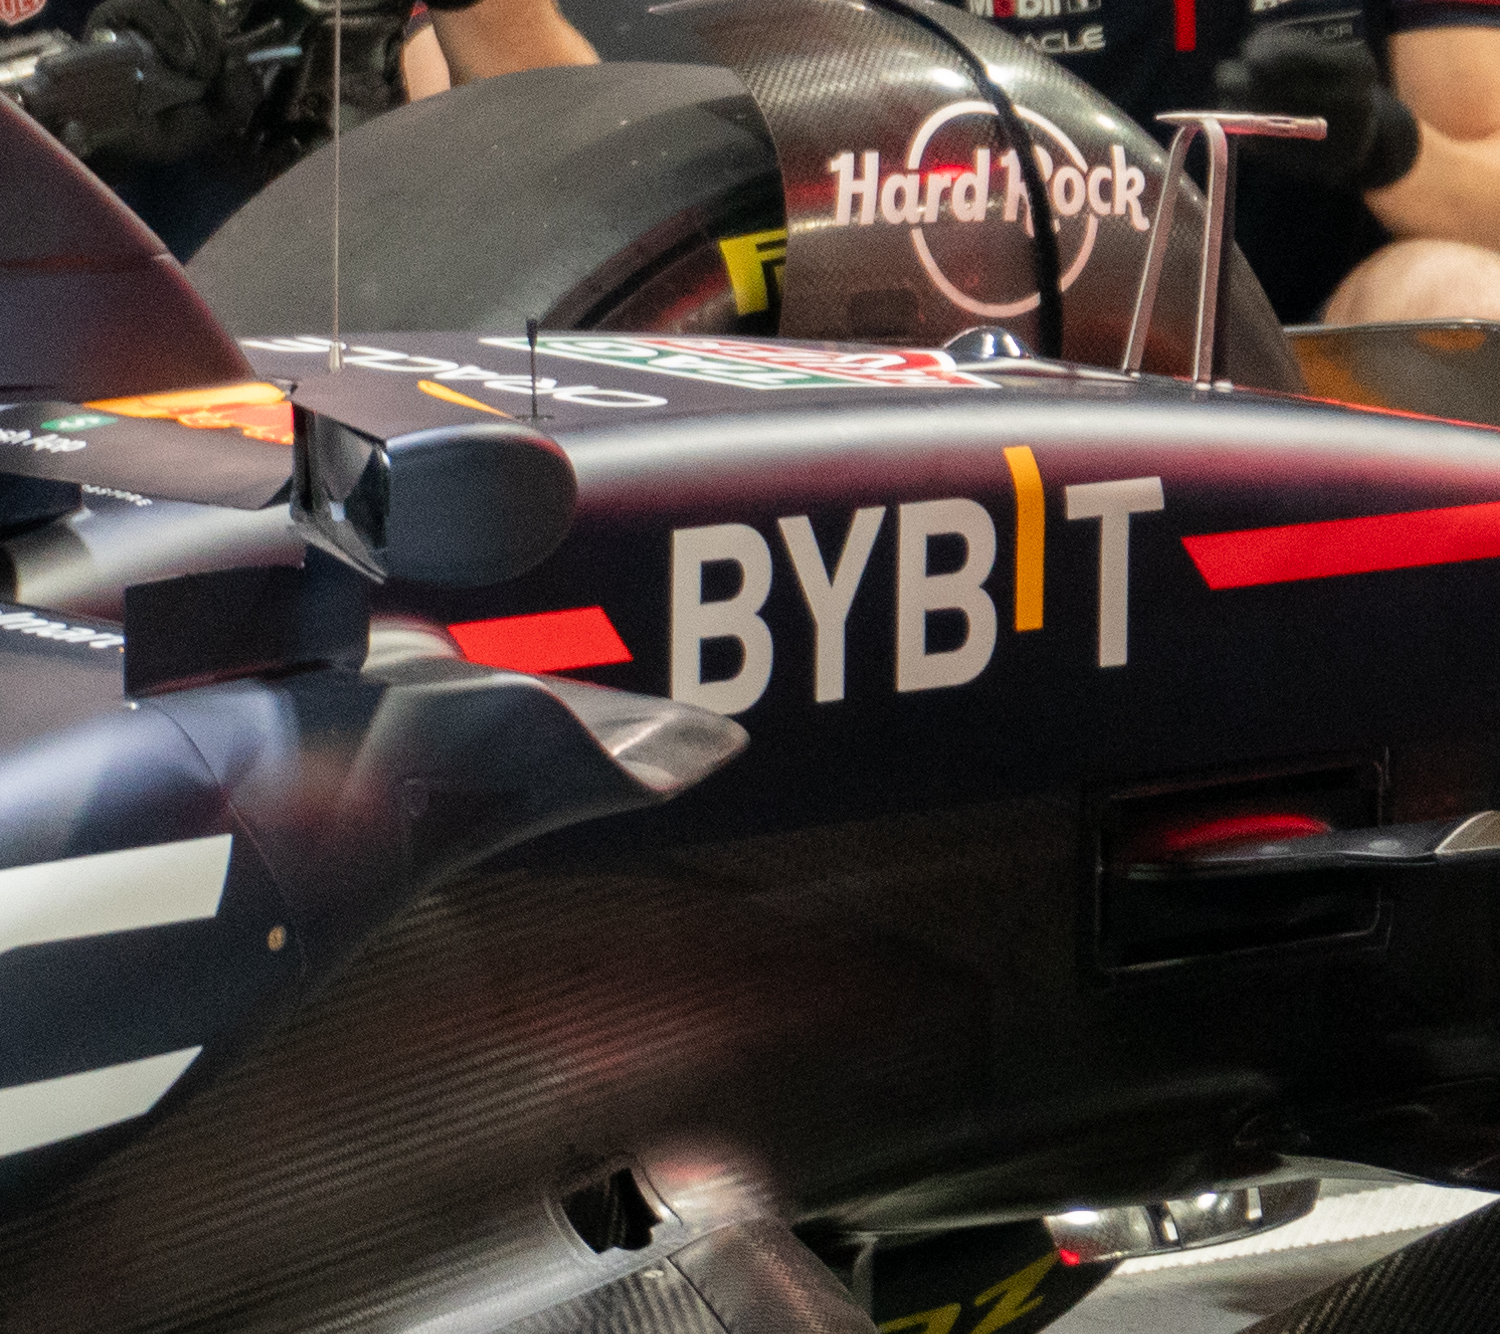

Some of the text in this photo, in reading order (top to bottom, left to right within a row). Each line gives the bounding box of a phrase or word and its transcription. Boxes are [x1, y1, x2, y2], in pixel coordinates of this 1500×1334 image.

[829, 146, 1151, 232] Hard Rock
[670, 446, 1165, 718] BYBIT
